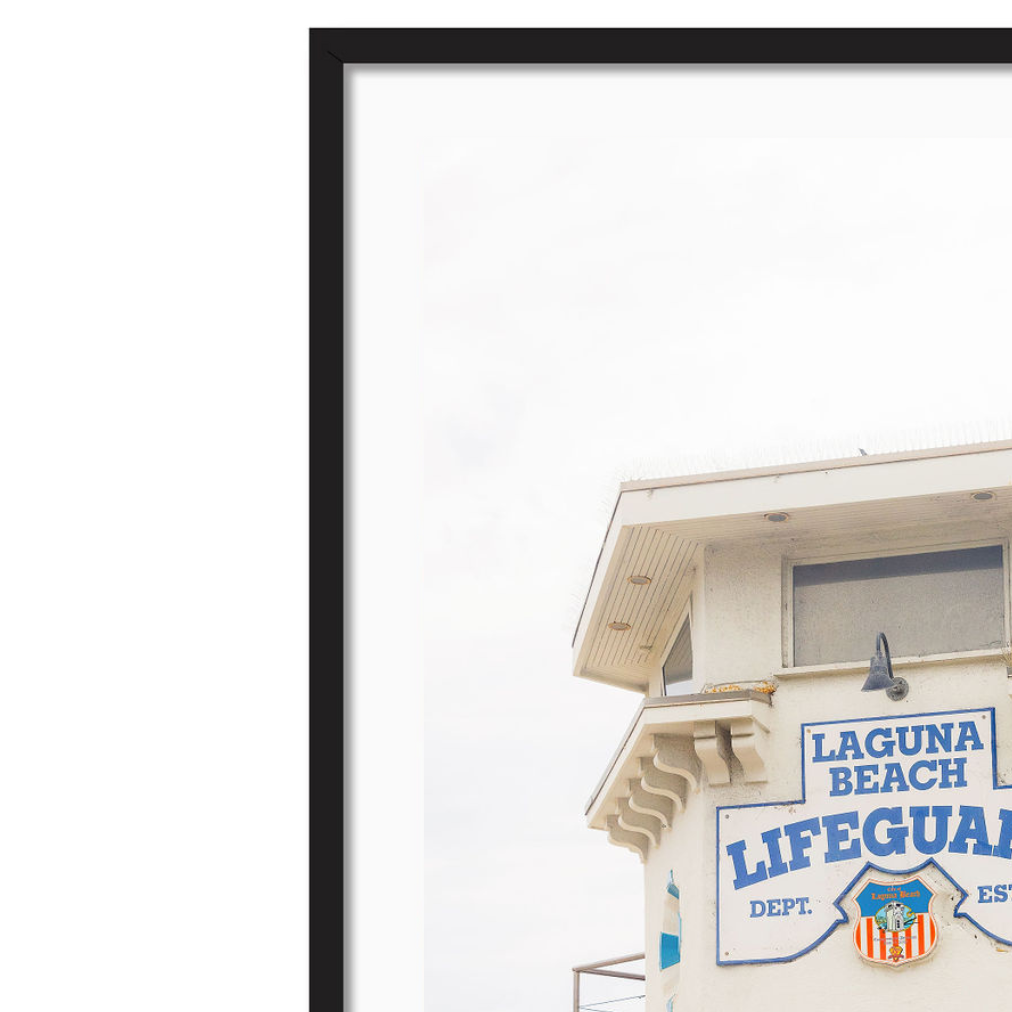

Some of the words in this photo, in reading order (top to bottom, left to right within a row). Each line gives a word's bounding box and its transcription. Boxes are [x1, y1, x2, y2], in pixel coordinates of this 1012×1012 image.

[812, 720, 984, 763] LAGUNA
[829, 757, 968, 798] BEACH
[749, 897, 813, 918] DEPT.
